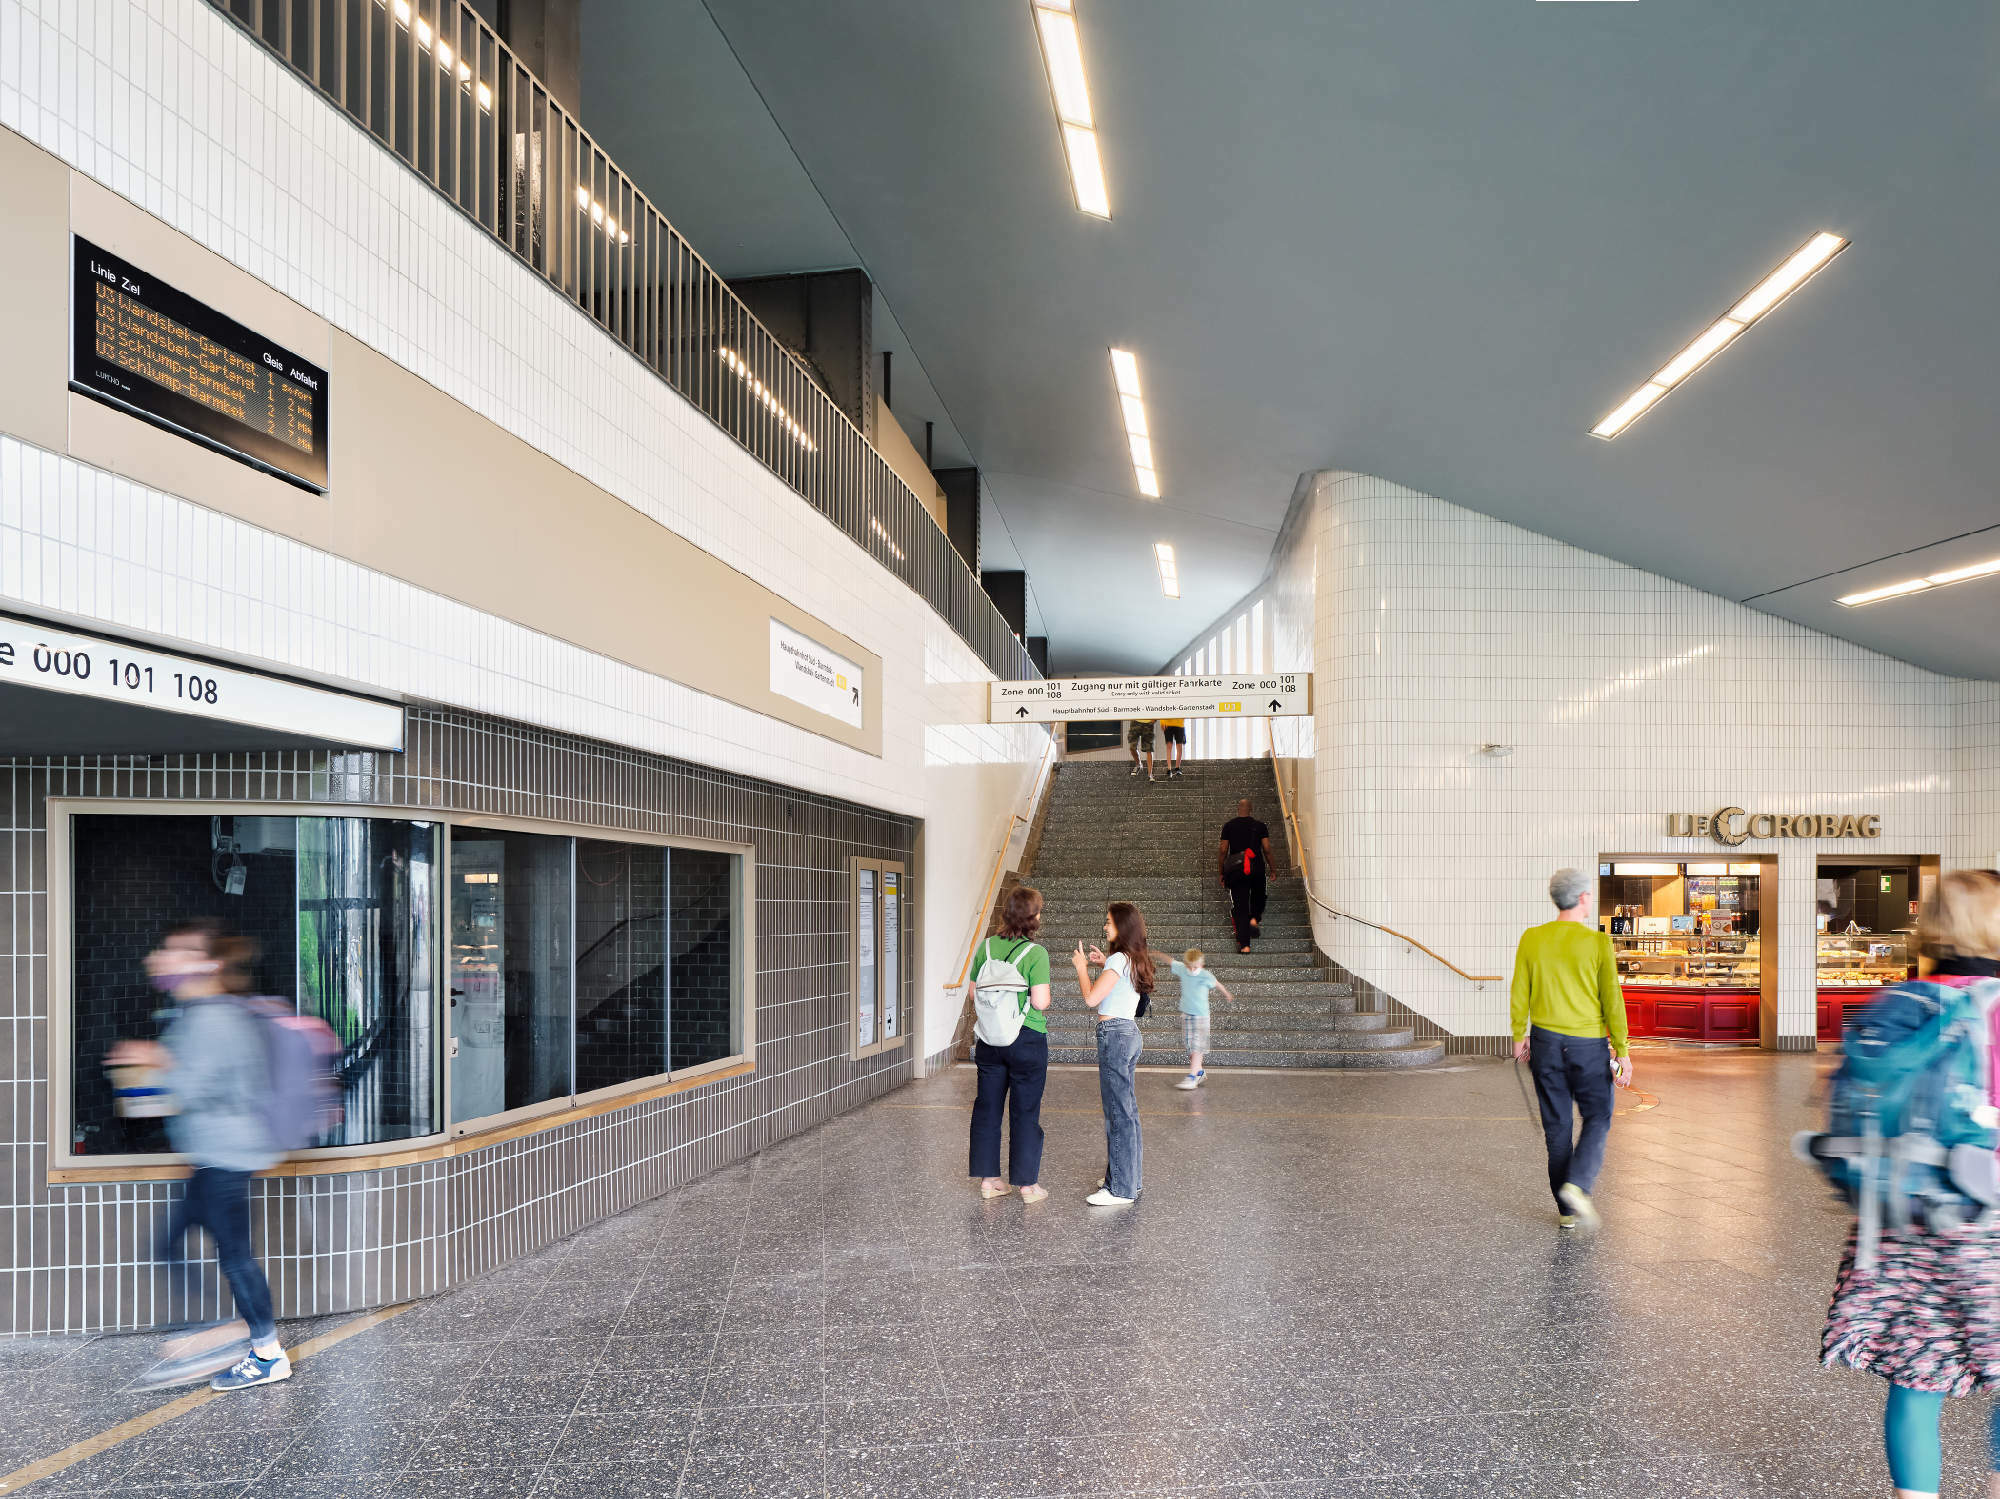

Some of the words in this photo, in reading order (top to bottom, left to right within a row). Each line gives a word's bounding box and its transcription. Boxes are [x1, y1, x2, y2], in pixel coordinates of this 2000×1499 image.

[90, 260, 116, 282] Linie
[96, 281, 115, 303] U3
[96, 301, 115, 322] U3
[96, 320, 115, 341] U3
[118, 331, 246, 403] Schlump-Barmbek
[96, 339, 115, 359] U3
[118, 350, 246, 419] Schlump-Barmbek
[33, 643, 91, 680] 000
[109, 659, 154, 693] 101
[173, 673, 218, 704] 108
[1232, 681, 1255, 690] Zone
[1280, 675, 1295, 684] 101
[1001, 688, 1024, 696] Zone
[1047, 683, 1061, 691] 101
[1047, 691, 1062, 699] 108
[1071, 682, 1106, 693] Zugang
[1108, 681, 1123, 690] nur
[1125, 680, 1140, 690] mit
[1141, 679, 1176, 691] gültiger
[1179, 678, 1222, 688] Fahrkarte
[1280, 684, 1296, 693] 108
[1052, 707, 1096, 715] Hauptbahnhof
[1669, 813, 1710, 838] LE
[1750, 813, 1882, 839] CROBAG
